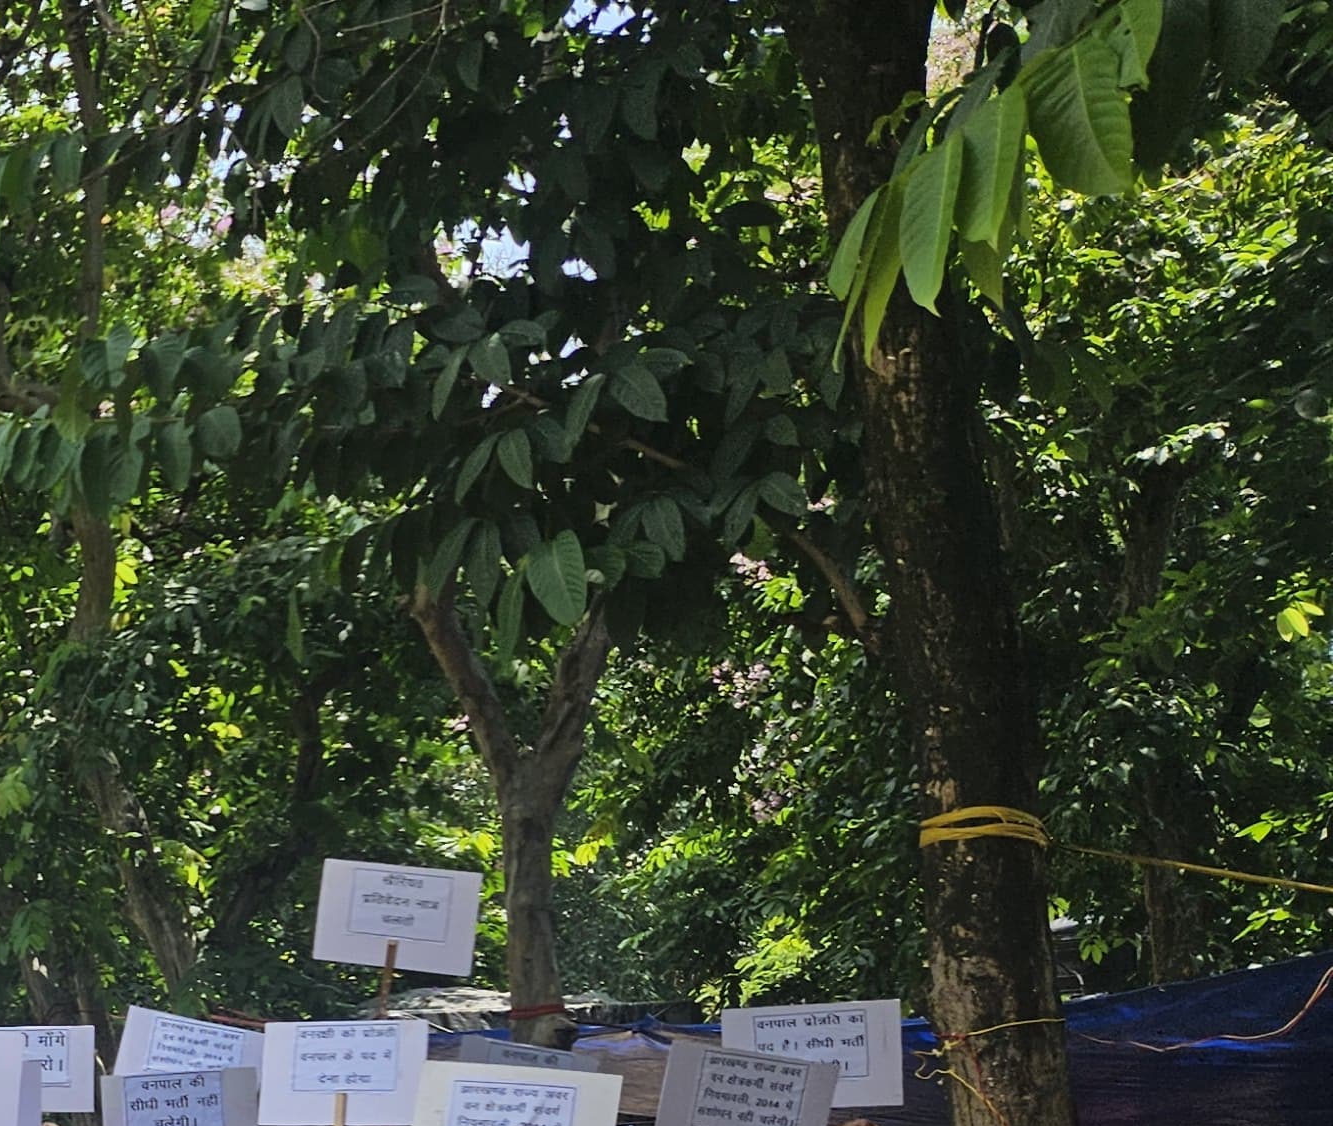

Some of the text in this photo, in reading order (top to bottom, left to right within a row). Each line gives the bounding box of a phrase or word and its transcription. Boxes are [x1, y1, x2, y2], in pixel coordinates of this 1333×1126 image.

[757, 1018, 797, 1029] वनपाल
[849, 1015, 863, 1024] का
[806, 1038, 834, 1049] सीधी
[842, 1035, 865, 1047] भर्ती
[141, 1075, 205, 1090] वनपाल की
[165, 1095, 189, 1109] भर्ती
